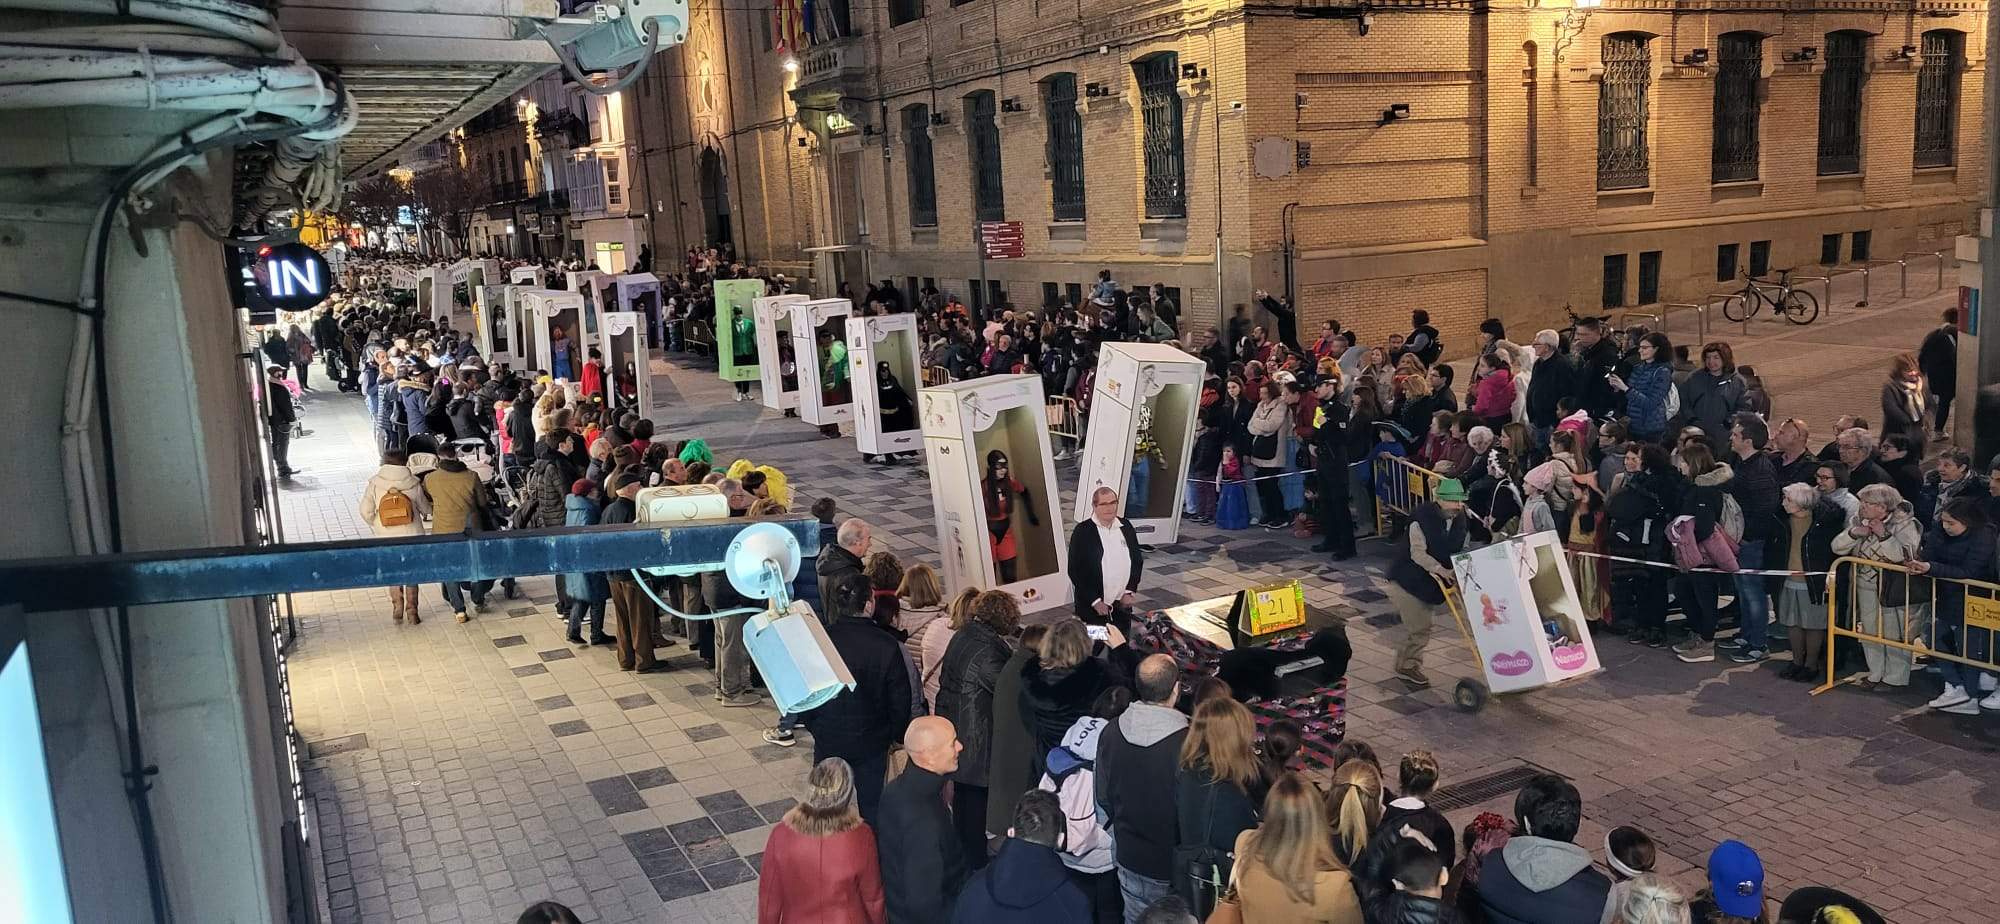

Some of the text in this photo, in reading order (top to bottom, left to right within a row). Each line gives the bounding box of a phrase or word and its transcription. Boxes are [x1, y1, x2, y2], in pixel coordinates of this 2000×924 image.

[267, 258, 321, 297] IN
[1268, 597, 1285, 616] 21
[1073, 719, 1099, 748] LOLA
